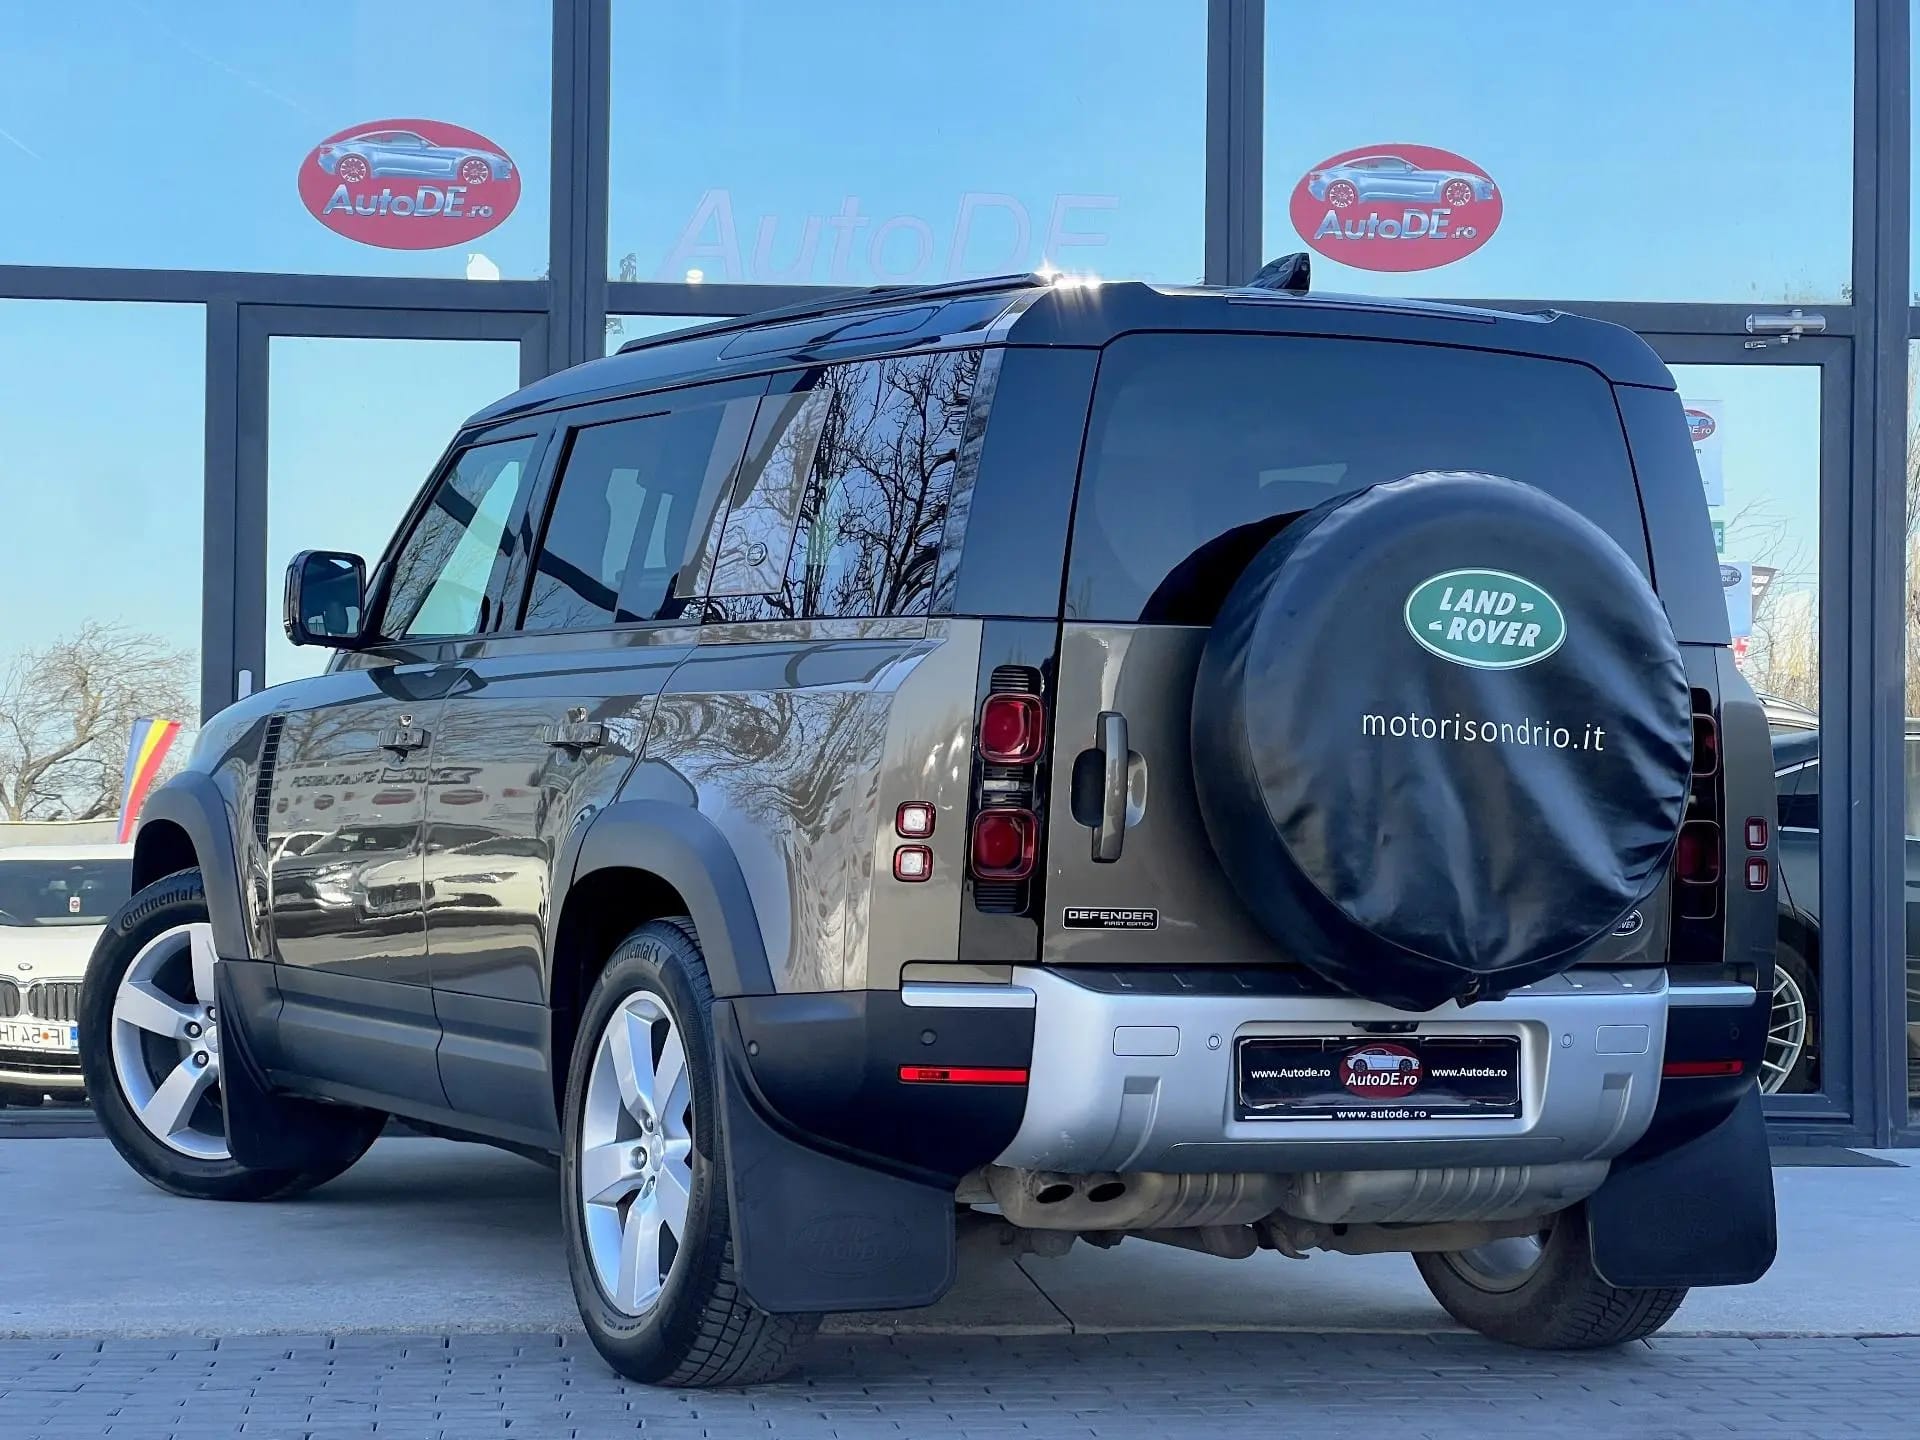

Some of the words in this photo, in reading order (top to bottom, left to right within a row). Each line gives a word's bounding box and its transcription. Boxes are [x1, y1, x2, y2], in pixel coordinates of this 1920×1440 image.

[1439, 587, 1517, 616] LAND
[1446, 617, 1542, 648] ROVER
[1362, 712, 1606, 752] motorisondrio.it
[1068, 910, 1154, 920] DEFENDER
[1251, 1067, 1331, 1079] www.Autode.ro
[1431, 1067, 1508, 1078] www.Autode.ro
[1346, 1072, 1418, 1088] AutoDE.ro
[1336, 1109, 1427, 1119] www.autode.ro
